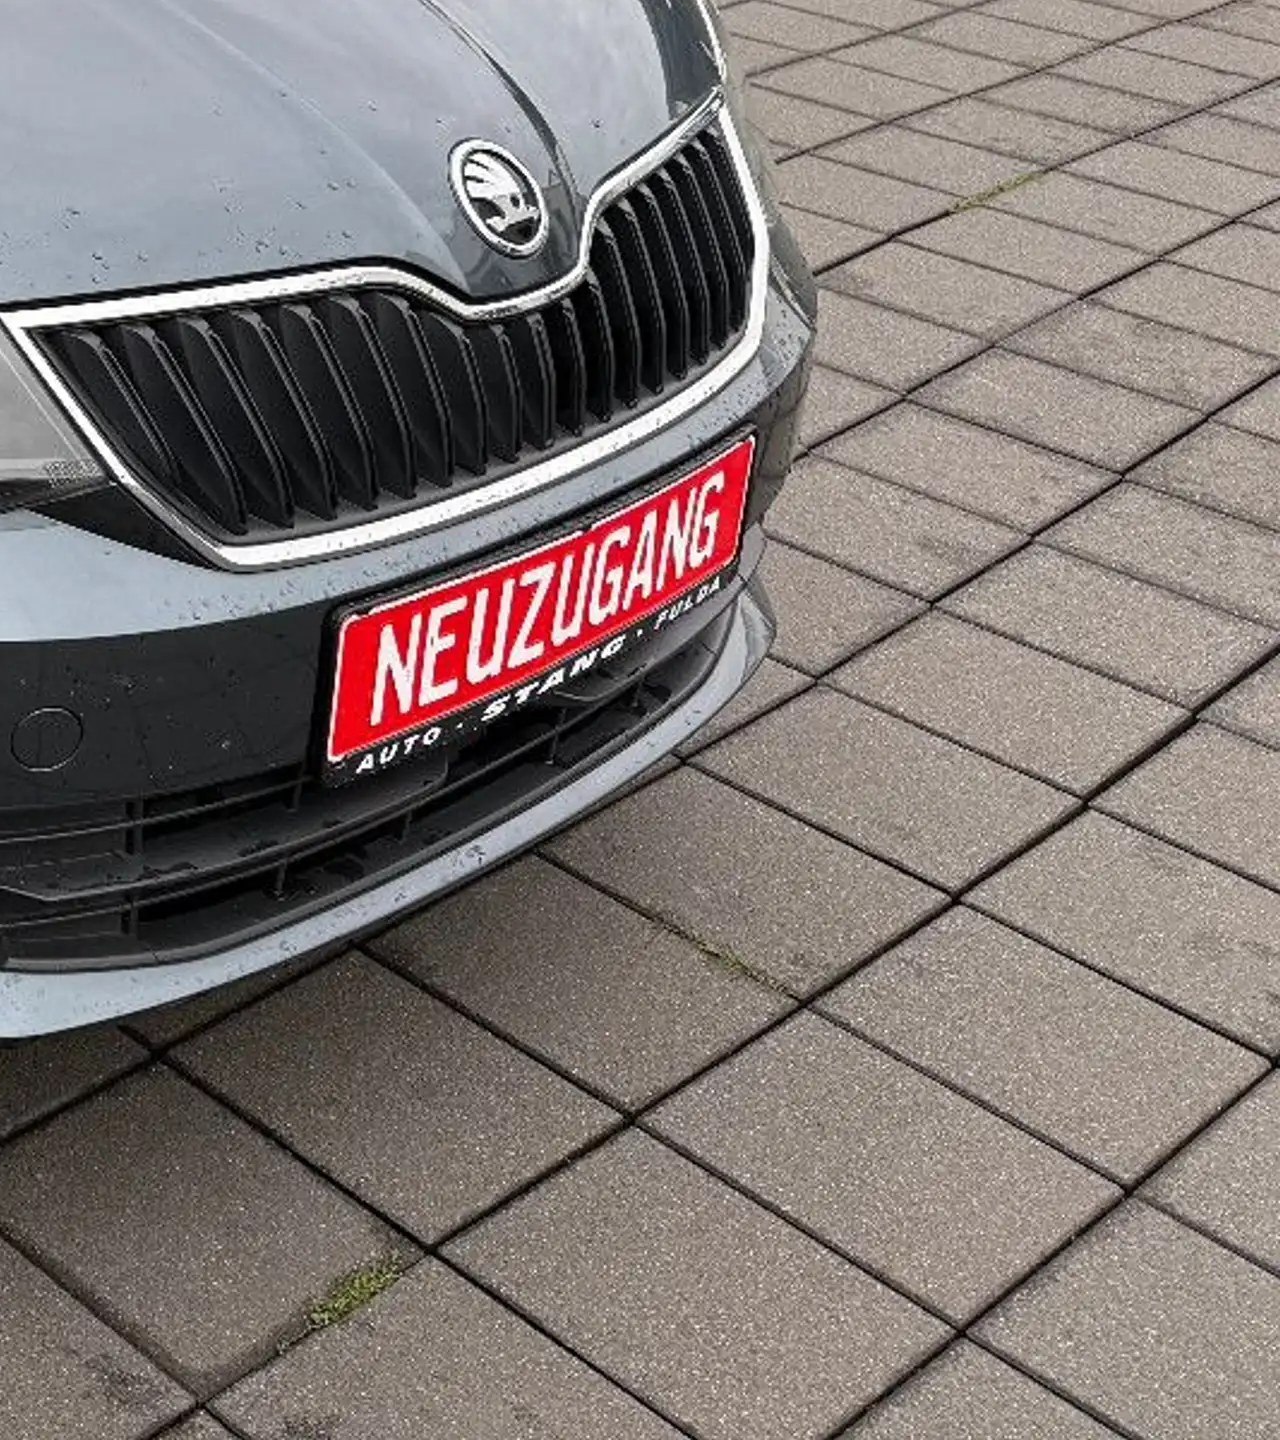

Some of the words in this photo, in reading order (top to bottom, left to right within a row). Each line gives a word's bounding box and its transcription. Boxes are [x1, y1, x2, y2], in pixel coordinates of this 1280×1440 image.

[355, 726, 441, 774] AUTO
[480, 634, 627, 722] STANG
[652, 575, 720, 631] FULDA
[369, 470, 725, 728] NEUZUGANG
